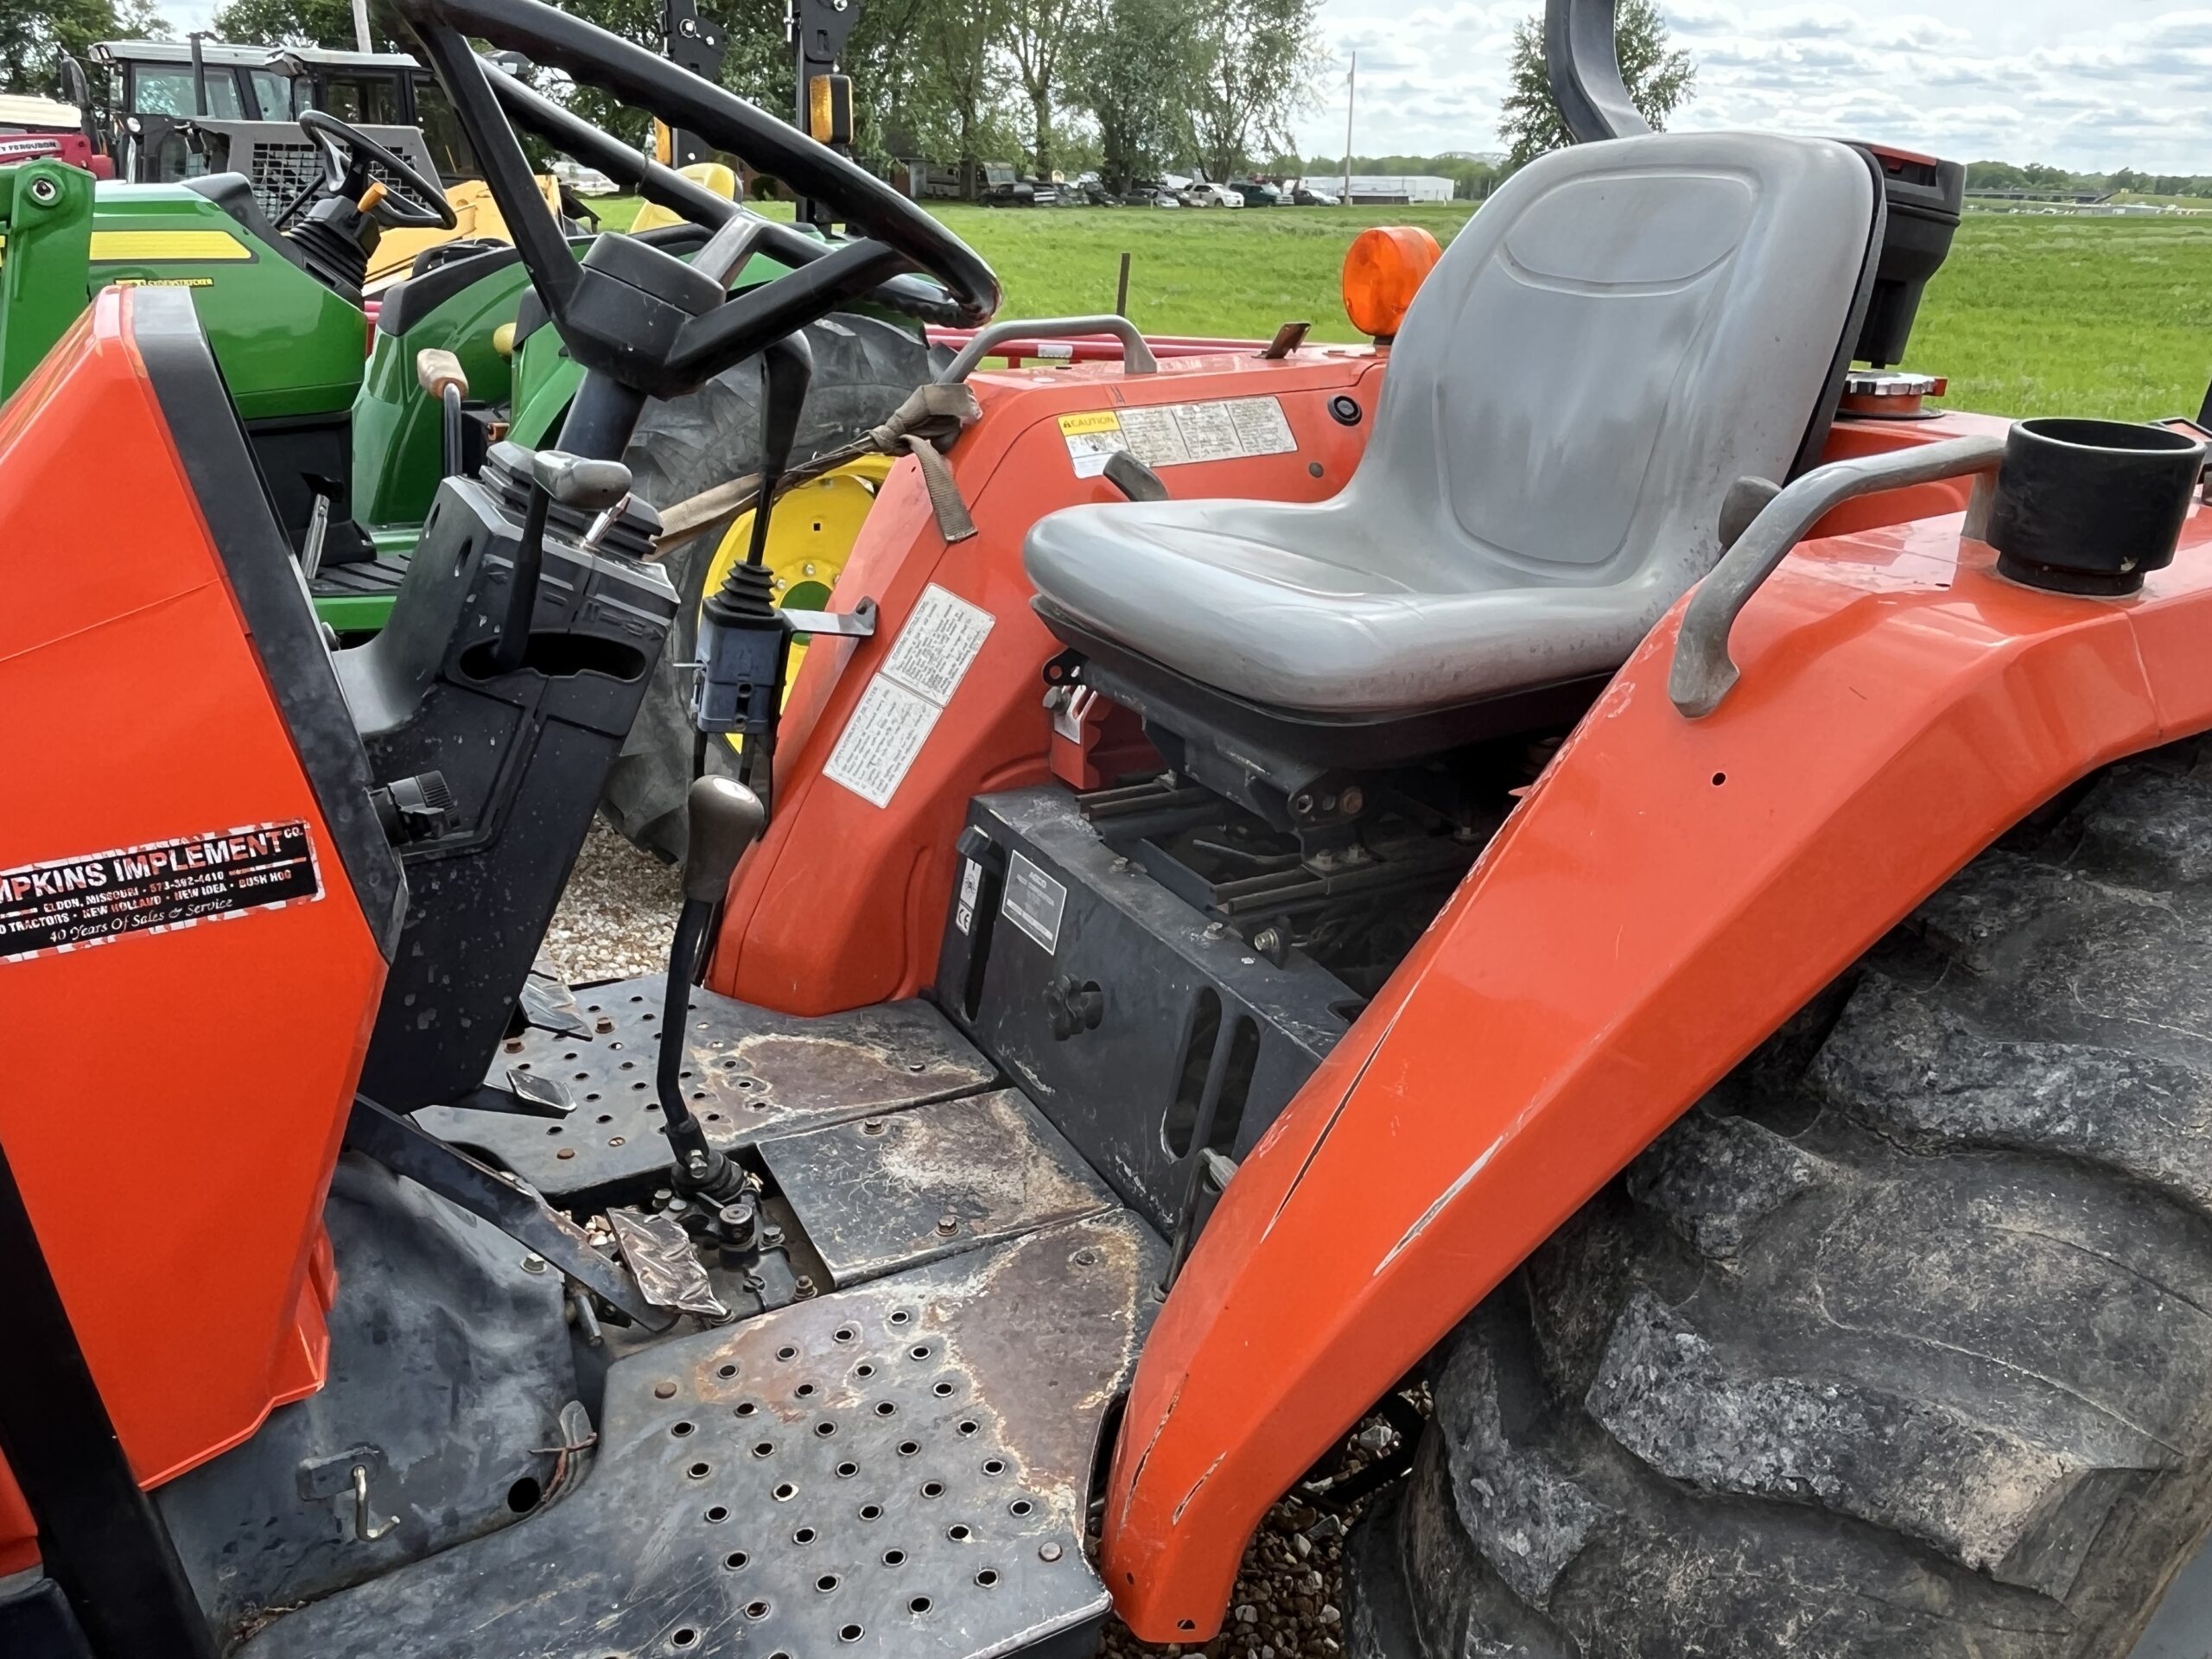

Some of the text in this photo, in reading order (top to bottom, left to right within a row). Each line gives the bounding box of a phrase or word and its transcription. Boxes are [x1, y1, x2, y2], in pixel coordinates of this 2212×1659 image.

[9, 142, 56, 150] FERGUSON
[1071, 416, 1115, 428] CAUTION
[113, 830, 283, 882] IMPLEMENT
[8, 913, 70, 933] TRACTORS
[82, 906, 108, 918] NEW
[111, 896, 162, 913] HOLLAND
[174, 887, 200, 901] NEW
[202, 883, 227, 896] IDEA
[238, 874, 268, 888] BUSH
[270, 869, 292, 883] HOG
[44, 871, 225, 912] ELDON, MISSOURI 573-392-4410
[49, 899, 233, 943] 40 Years Of Sales & Service
